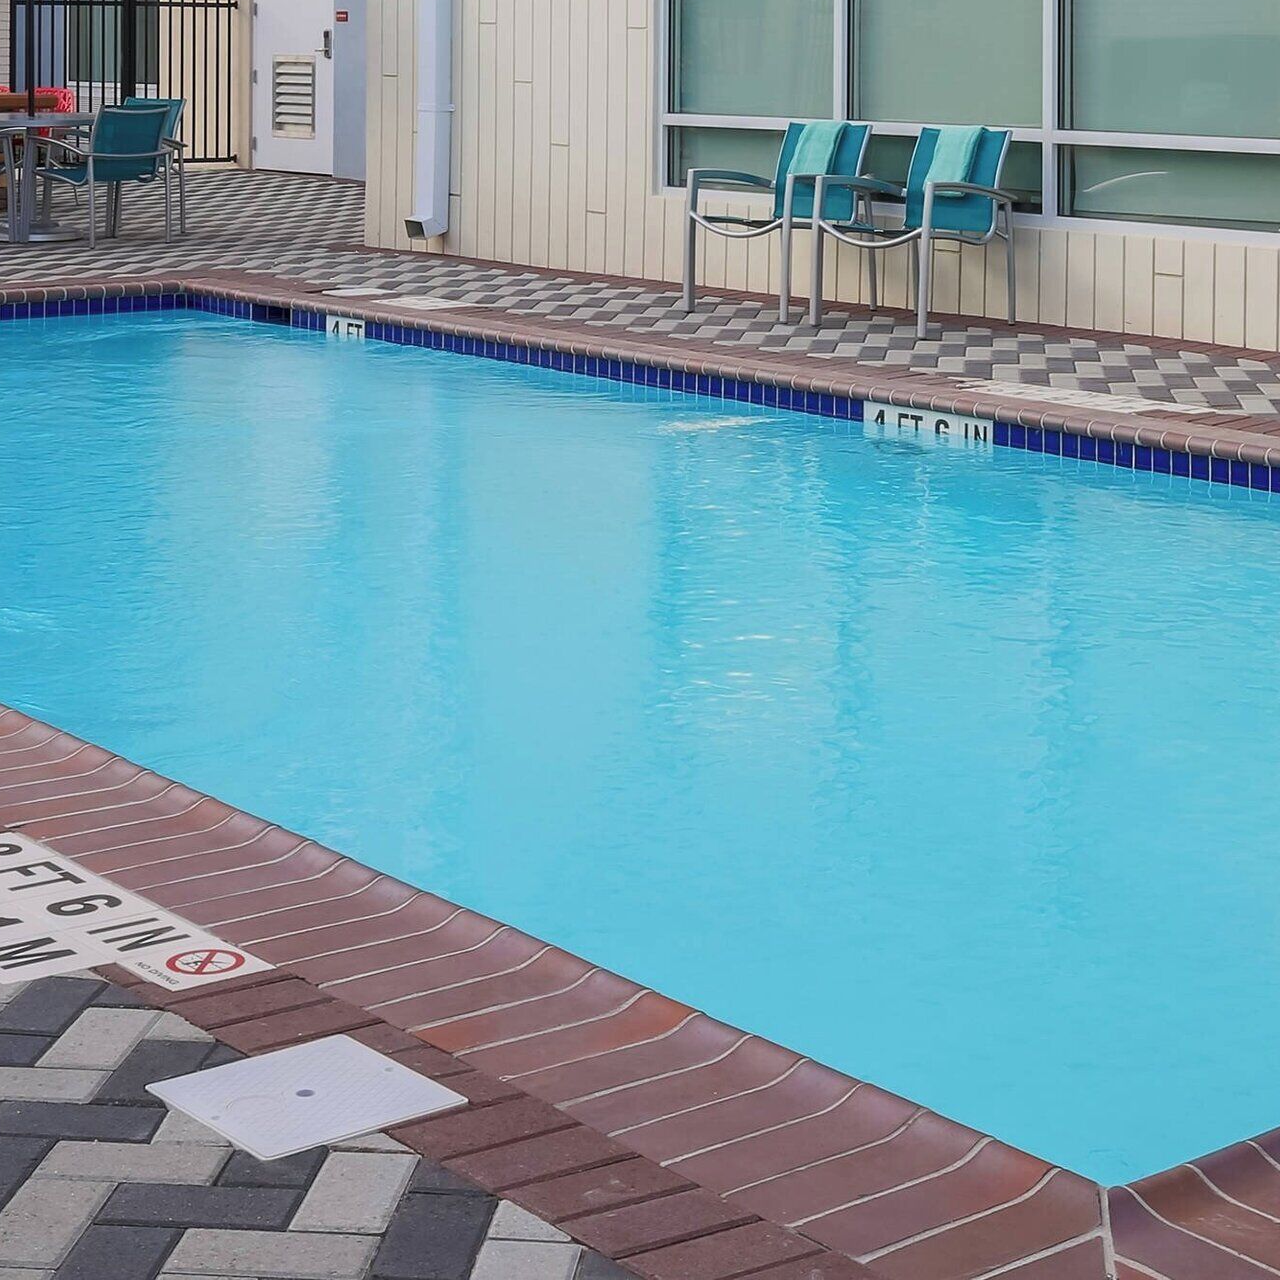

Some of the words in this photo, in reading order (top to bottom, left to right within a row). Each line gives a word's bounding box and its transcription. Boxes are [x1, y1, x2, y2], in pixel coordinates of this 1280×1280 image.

[346, 322, 363, 337] FT
[873, 409, 885, 425] 4
[897, 413, 923, 431] FT
[964, 422, 988, 442] IN
[46, 894, 122, 917] 6
[86, 917, 191, 953] IN
[134, 960, 153, 970] NO
[148, 968, 180, 986] DIVING
